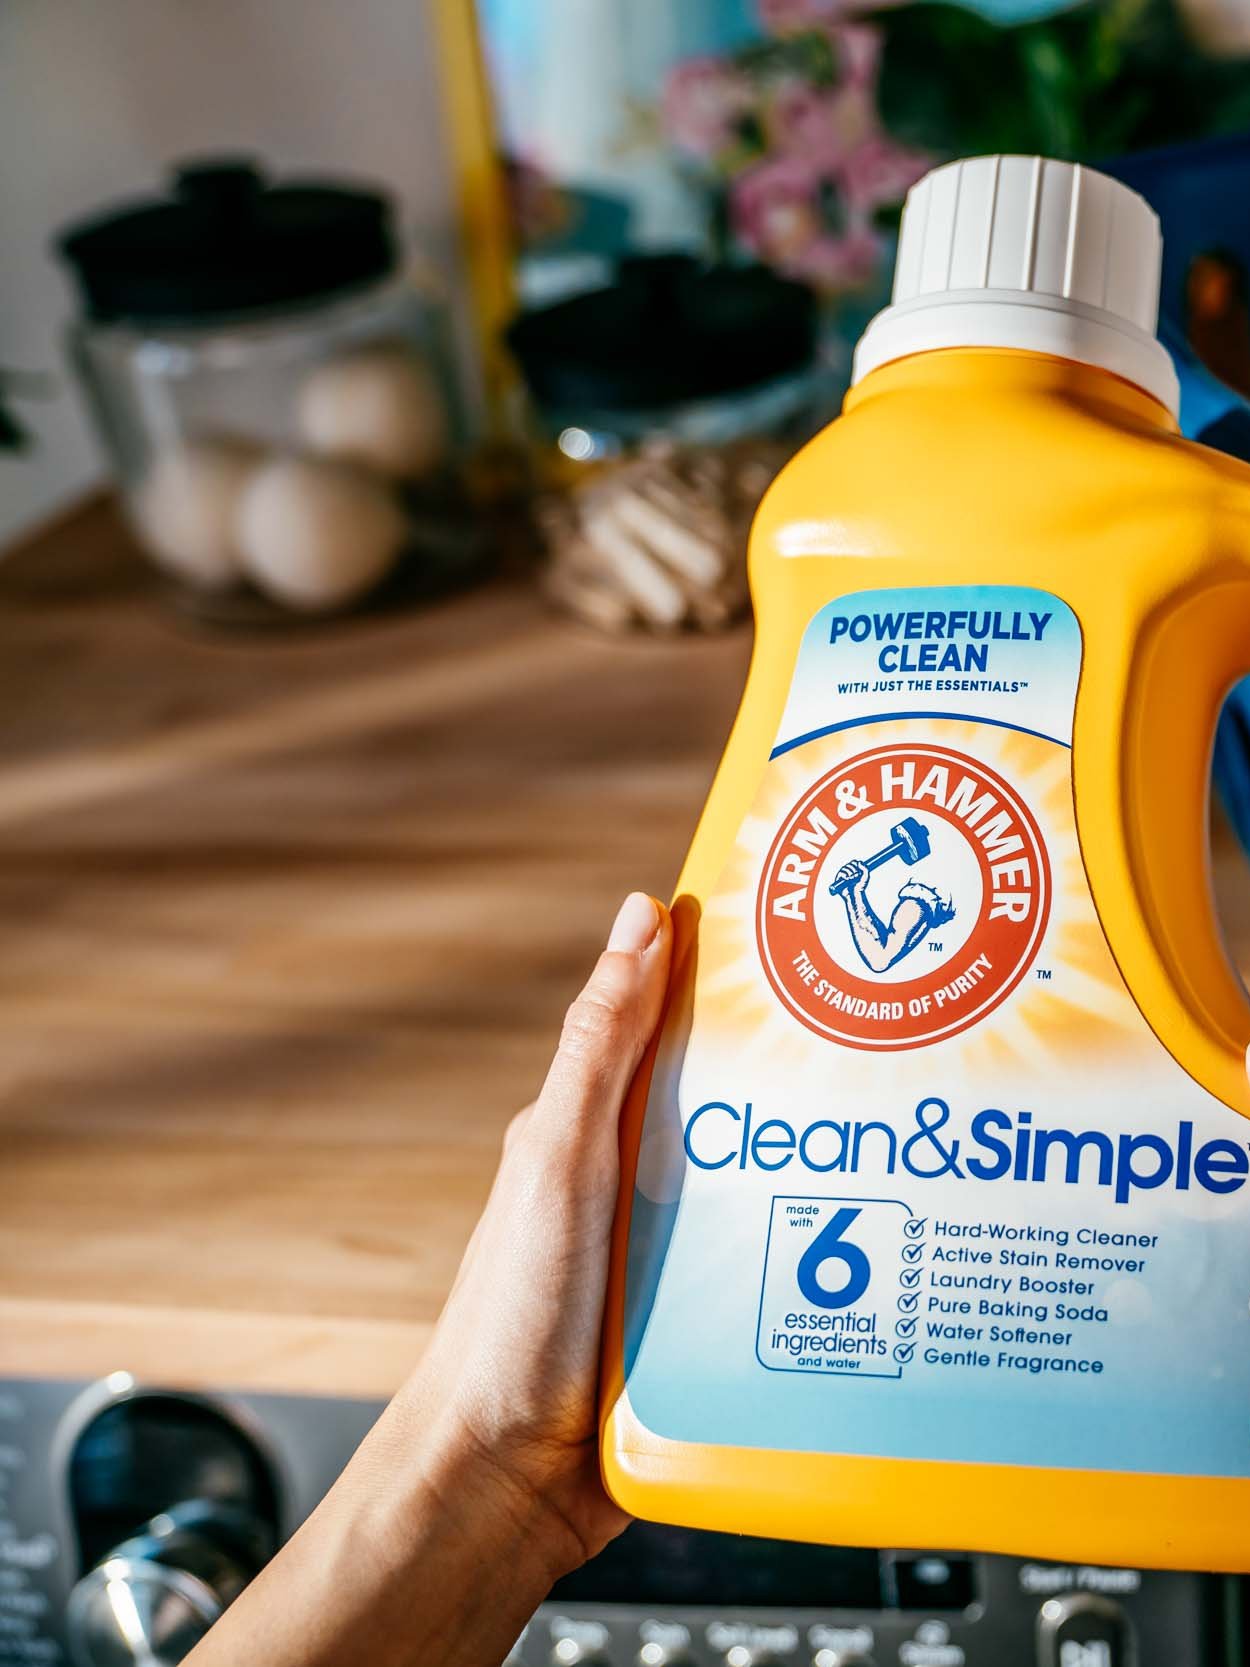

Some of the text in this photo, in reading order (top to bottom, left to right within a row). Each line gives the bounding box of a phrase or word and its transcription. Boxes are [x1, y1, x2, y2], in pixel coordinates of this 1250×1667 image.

[829, 612, 1052, 644] POWERFULLY
[878, 644, 988, 672] CLEAN
[837, 682, 869, 694] WITH
[872, 681, 903, 692] JUST
[907, 680, 932, 691] THE
[773, 761, 1031, 922] ARM & HAMMER
[792, 950, 993, 1020] THE STANDARD OF PURITY
[786, 1205, 820, 1216] made
[790, 1217, 814, 1229] with
[934, 1220, 1159, 1248] Hard-Working Cleaner
[796, 1207, 871, 1310] 6
[931, 1247, 1146, 1274] Active Stain Remover
[930, 1272, 1095, 1296] Laundry Booster
[784, 1311, 876, 1334] essential
[927, 1297, 1109, 1323] Pure Baking Soda
[771, 1329, 888, 1356] ingredients
[926, 1323, 1073, 1347] Water Softener
[797, 1357, 862, 1370] and water
[923, 1348, 1105, 1377] Gentle Fragrance
